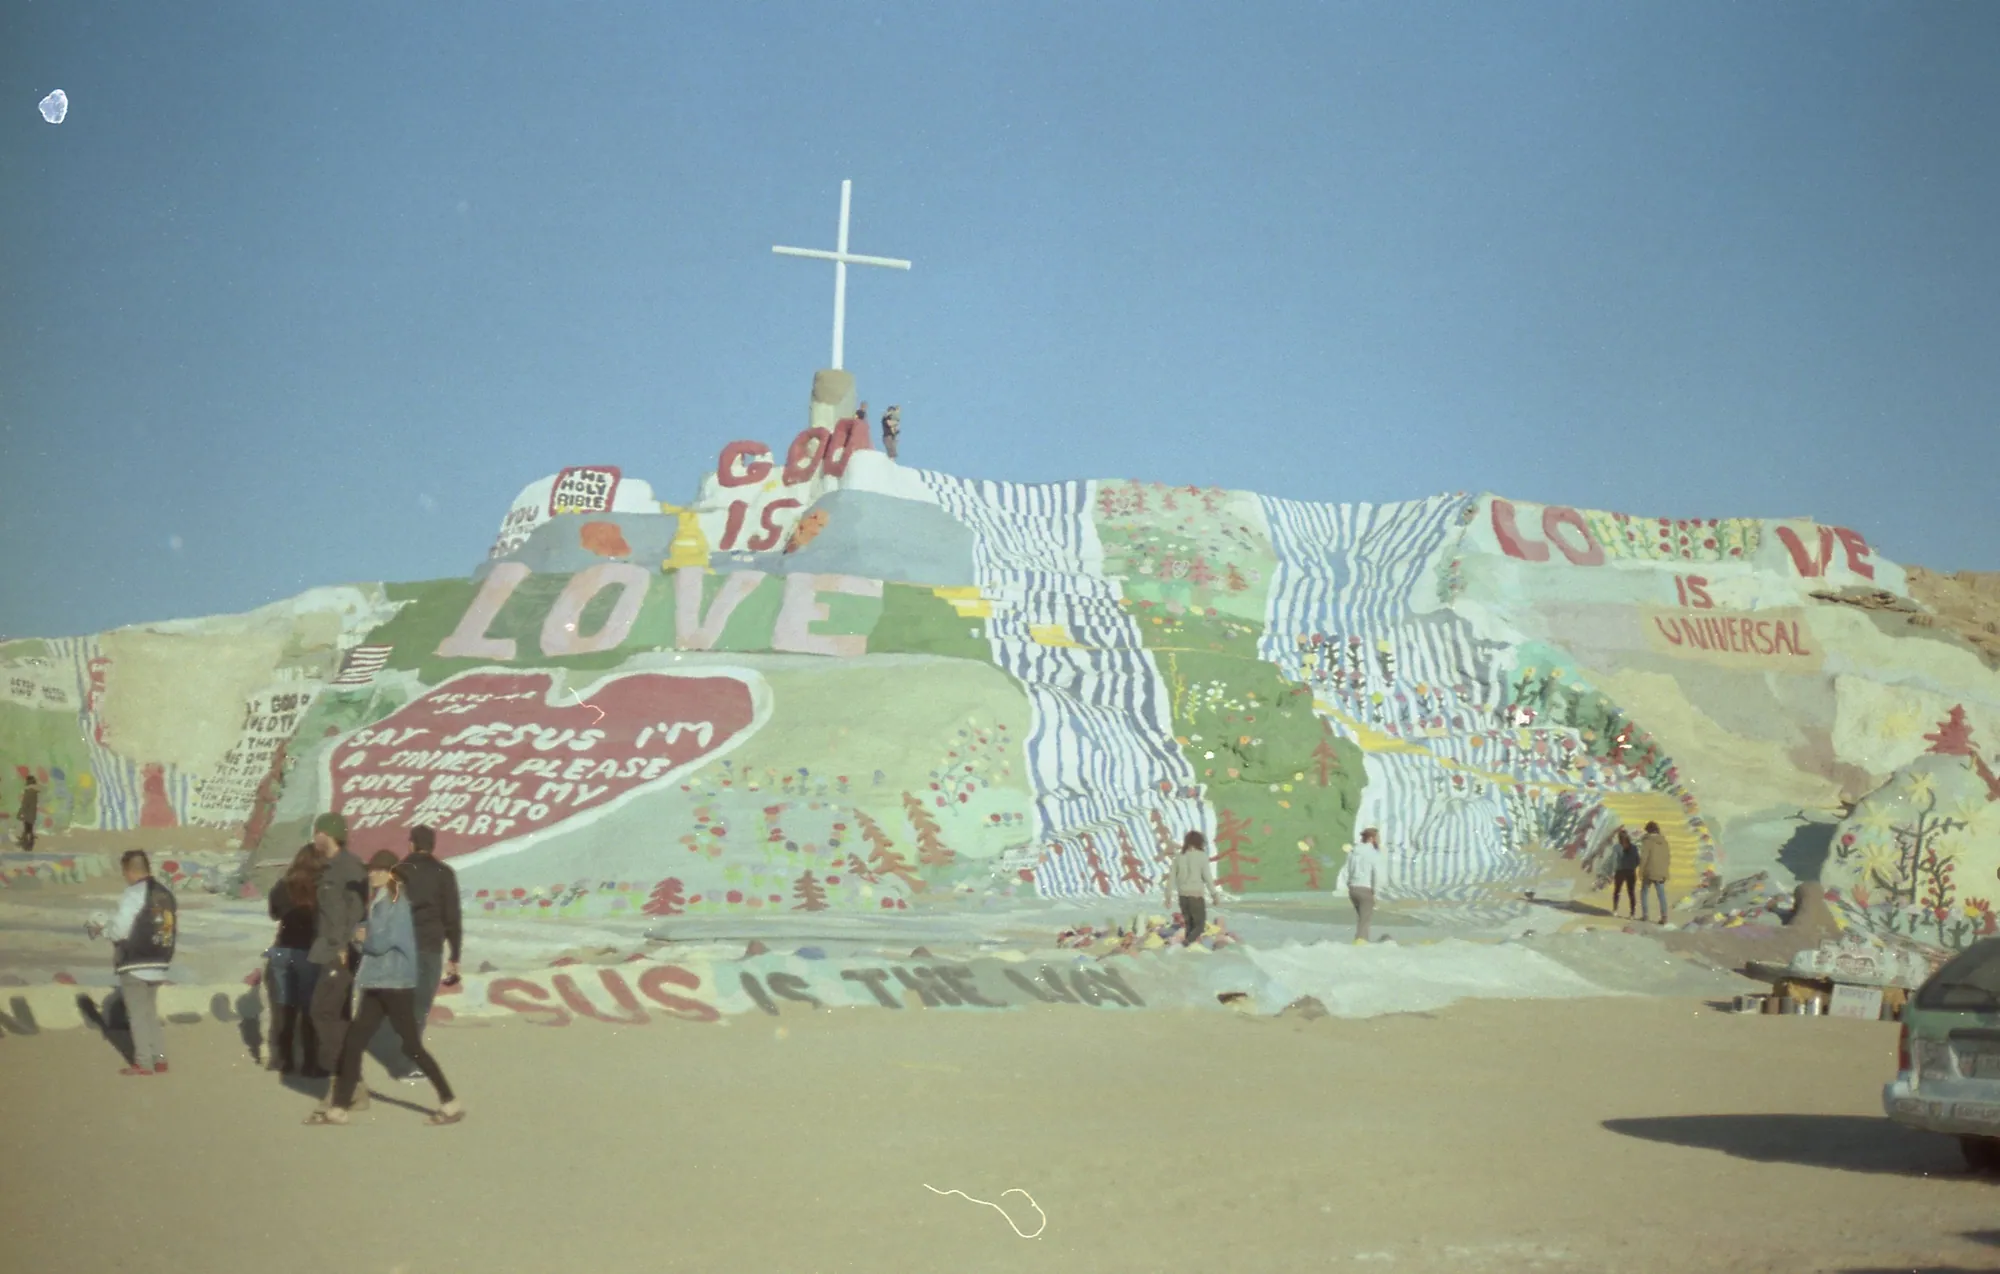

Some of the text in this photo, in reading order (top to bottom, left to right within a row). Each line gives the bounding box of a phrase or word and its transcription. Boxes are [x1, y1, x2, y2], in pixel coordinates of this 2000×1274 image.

[718, 418, 871, 488] GOD
[556, 493, 605, 509] BIBLE
[560, 479, 606, 496] HOLY
[720, 498, 803, 551] IS
[1675, 575, 1713, 609] IS
[437, 561, 884, 661] LOVE
[1655, 615, 1810, 656] UNIVERSAL
[348, 721, 714, 751] SAY JESUS I'M
[339, 749, 671, 780] A SINNER PLEASE
[342, 774, 609, 806] COME UPON MY
[352, 809, 516, 836] MY HEART
[413, 792, 471, 812] AND
[475, 795, 549, 821] INTO
[739, 971, 825, 1016] IS
[840, 965, 1008, 1009] THE
